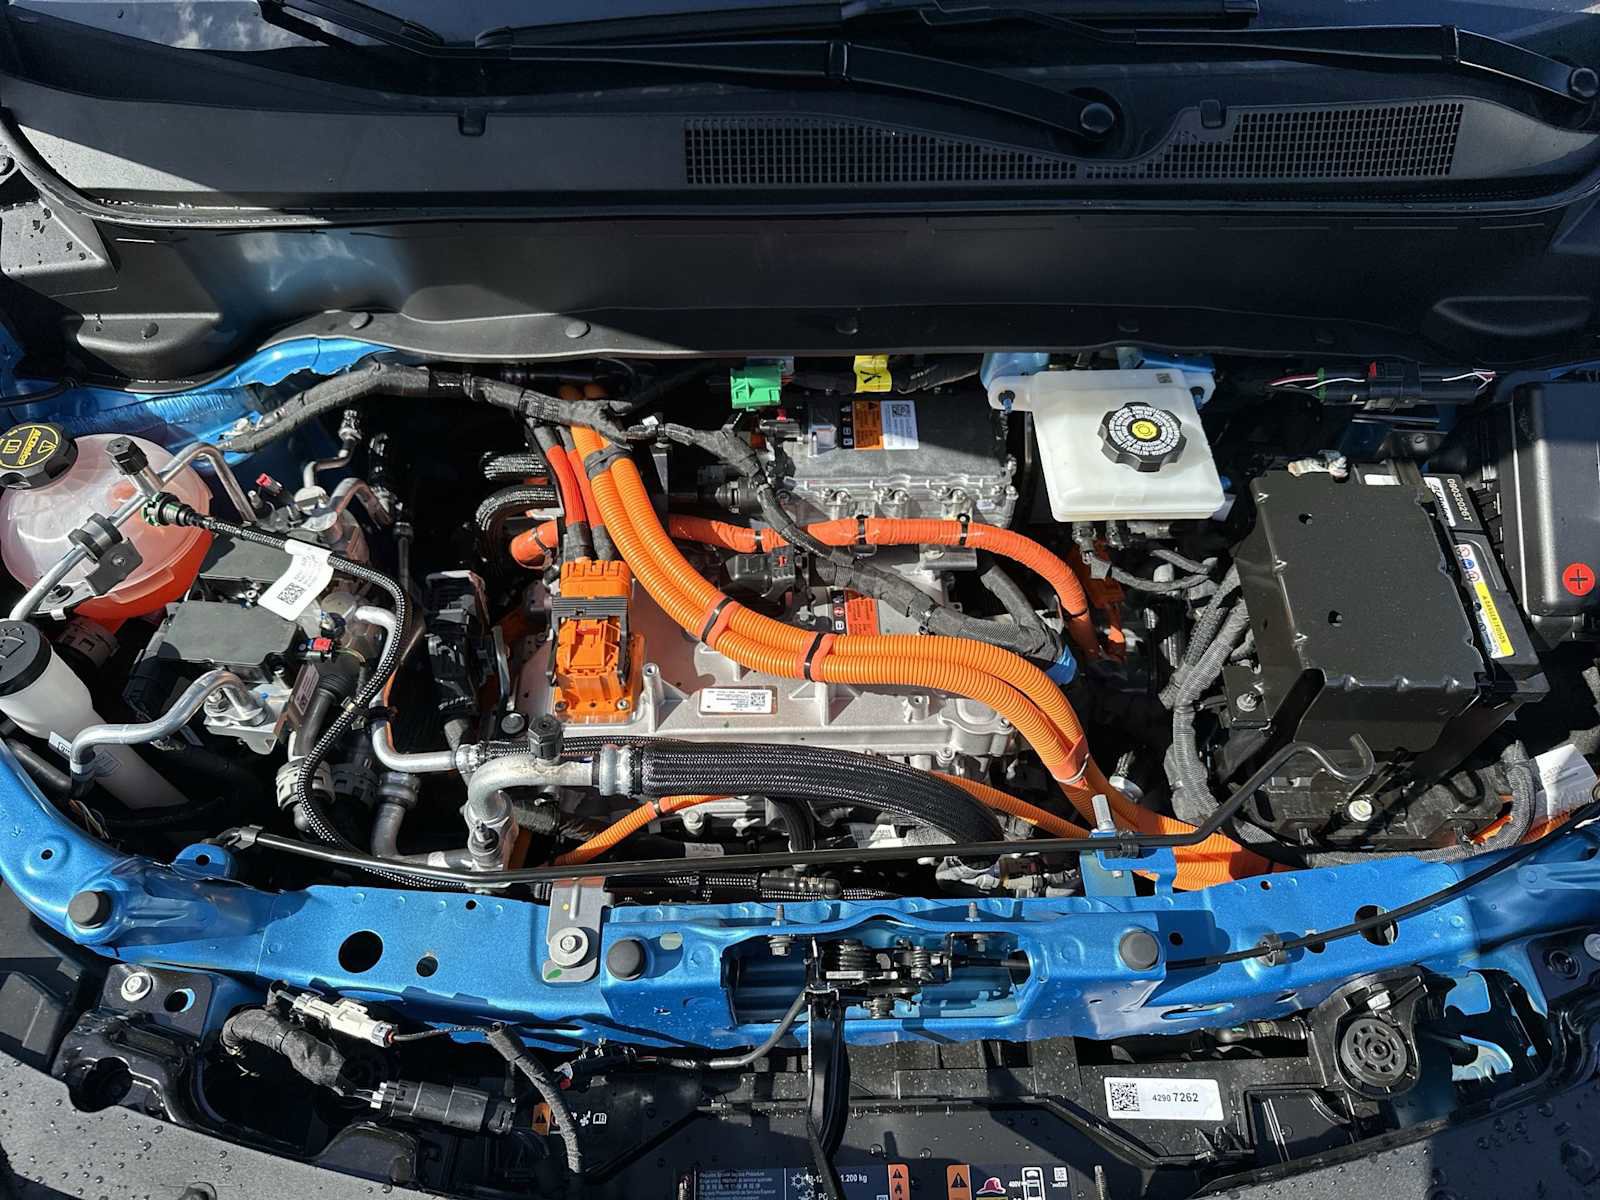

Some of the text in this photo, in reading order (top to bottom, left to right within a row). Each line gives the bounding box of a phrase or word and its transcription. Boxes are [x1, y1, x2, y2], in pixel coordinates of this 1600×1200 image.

[1152, 1092, 1199, 1103] 4290 7262
[840, 1174, 857, 1182] 1.200
[859, 1174, 868, 1183] kg
